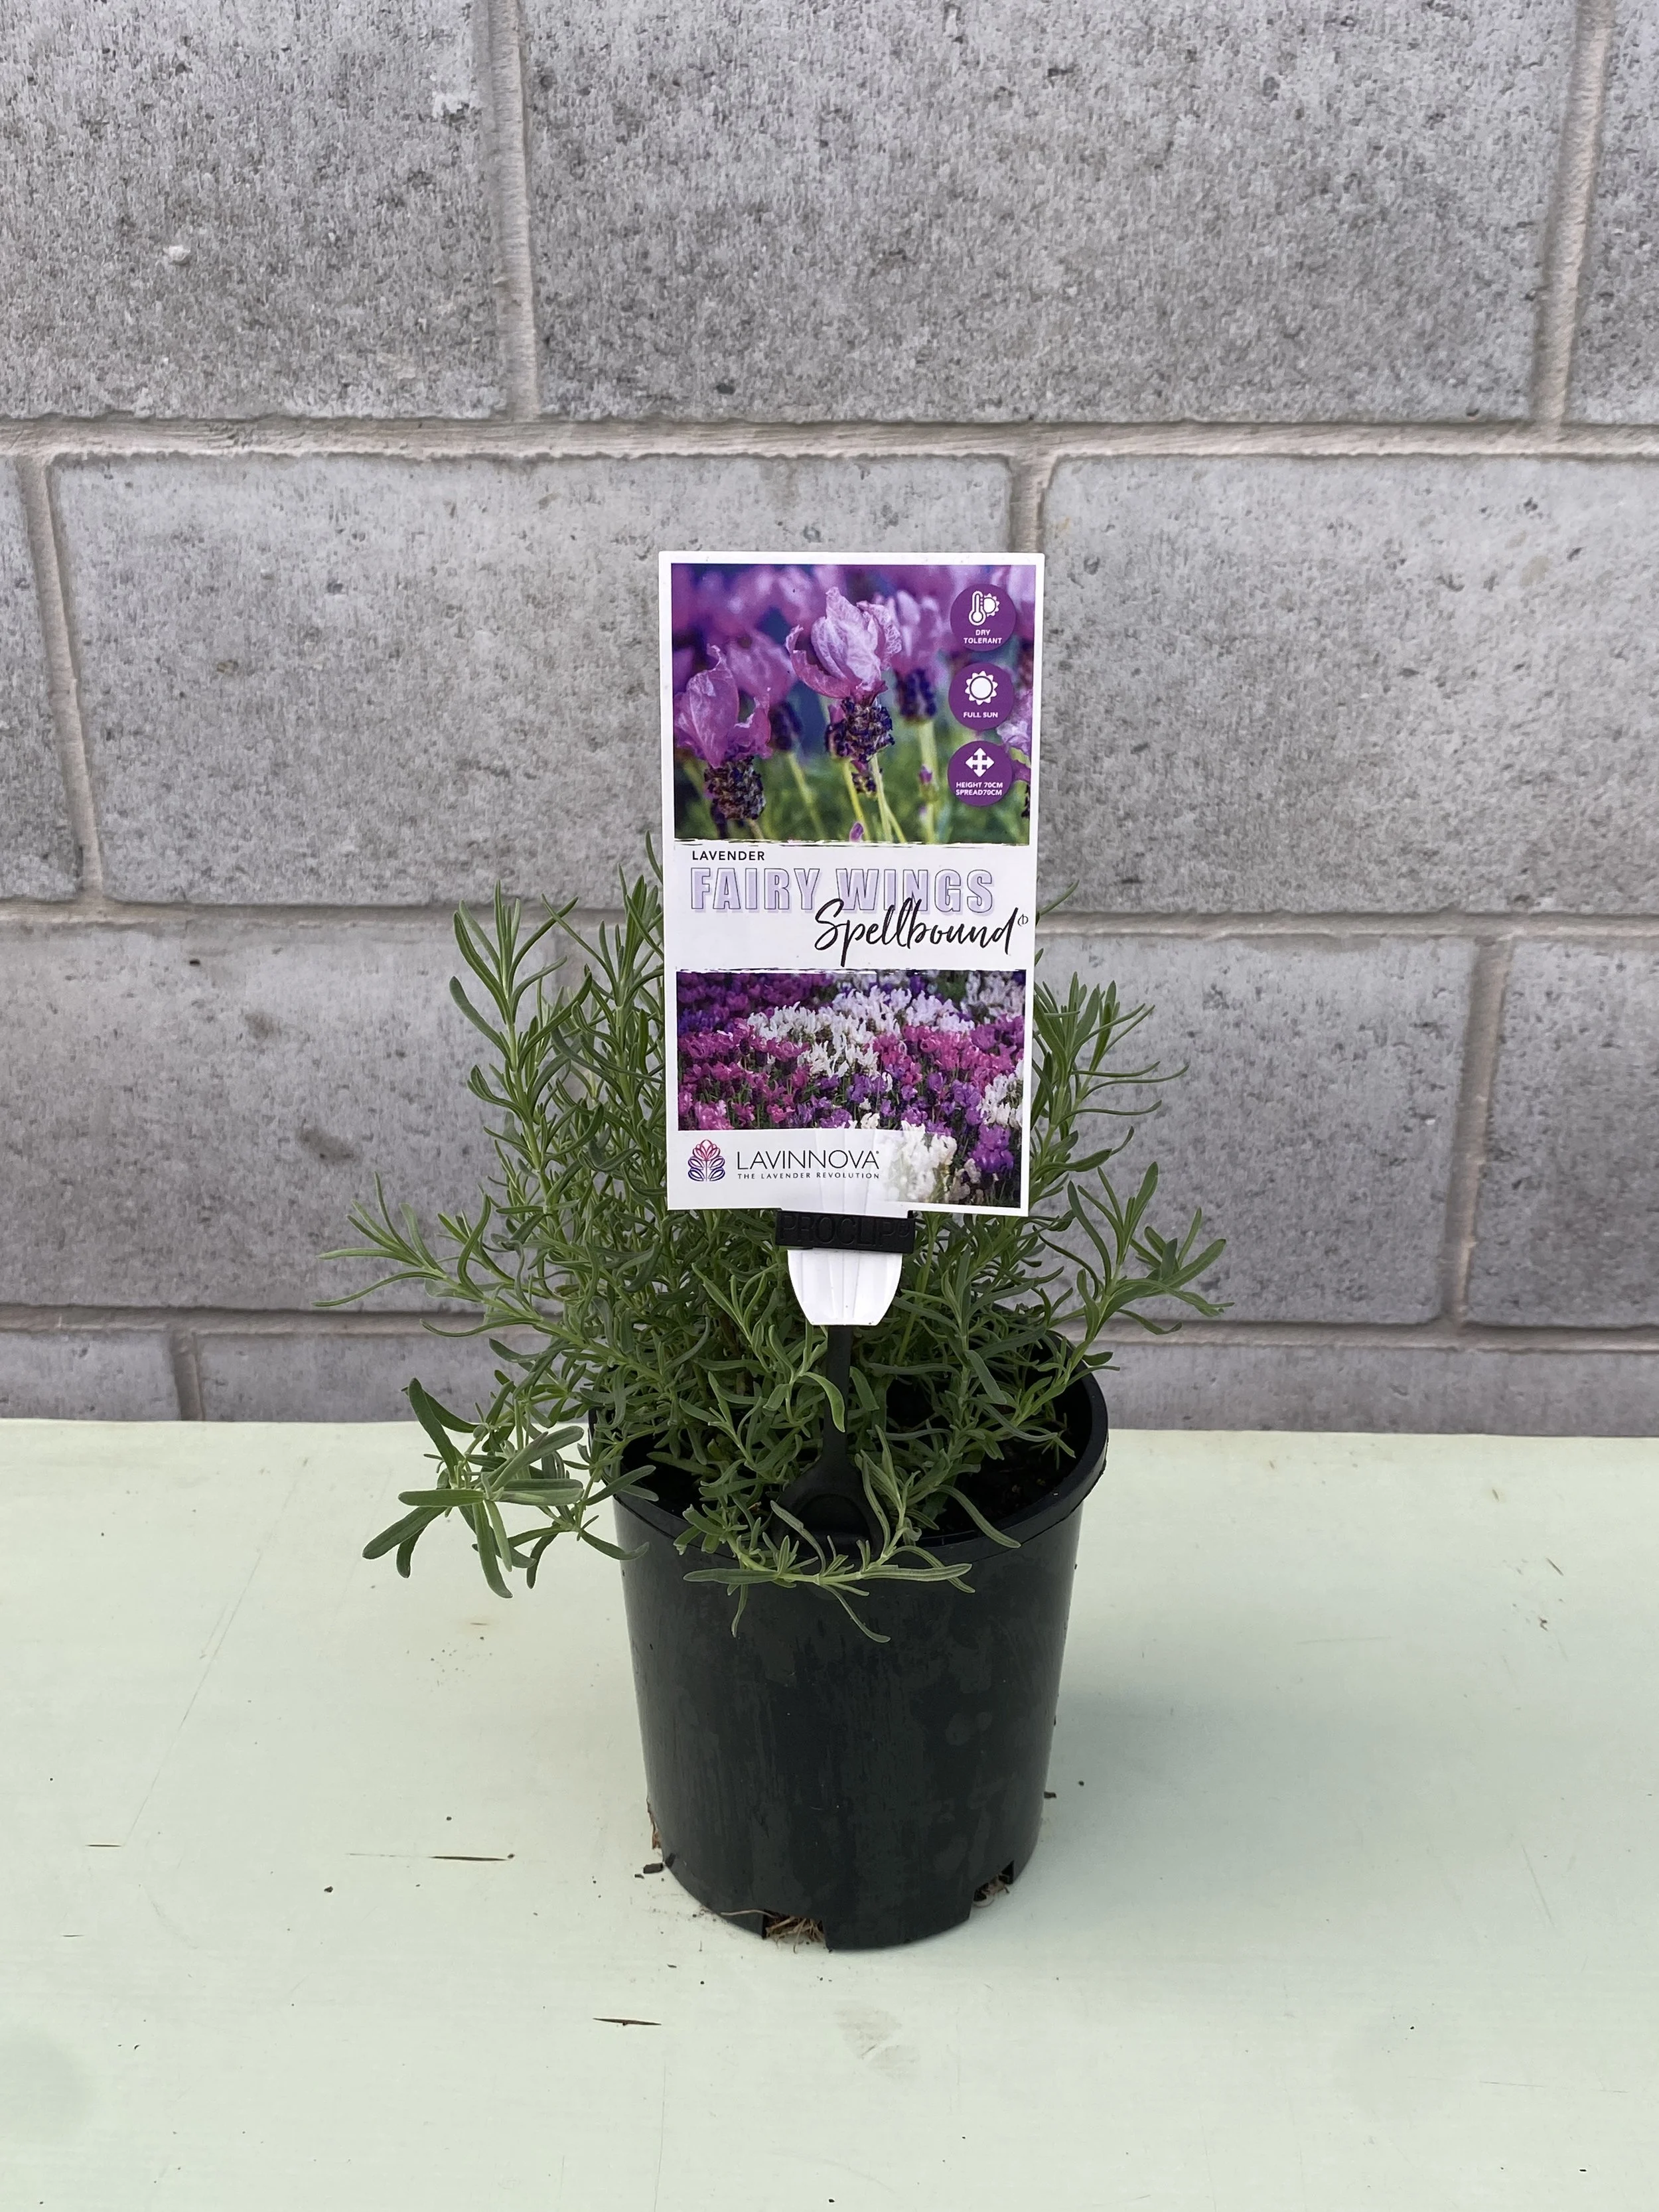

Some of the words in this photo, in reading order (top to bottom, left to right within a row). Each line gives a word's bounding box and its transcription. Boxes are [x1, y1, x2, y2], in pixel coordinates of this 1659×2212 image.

[691, 850, 765, 861] LAVENDER
[690, 867, 822, 913] FAIRY
[835, 867, 995, 915] WINGS
[814, 898, 1019, 968] Spellbound
